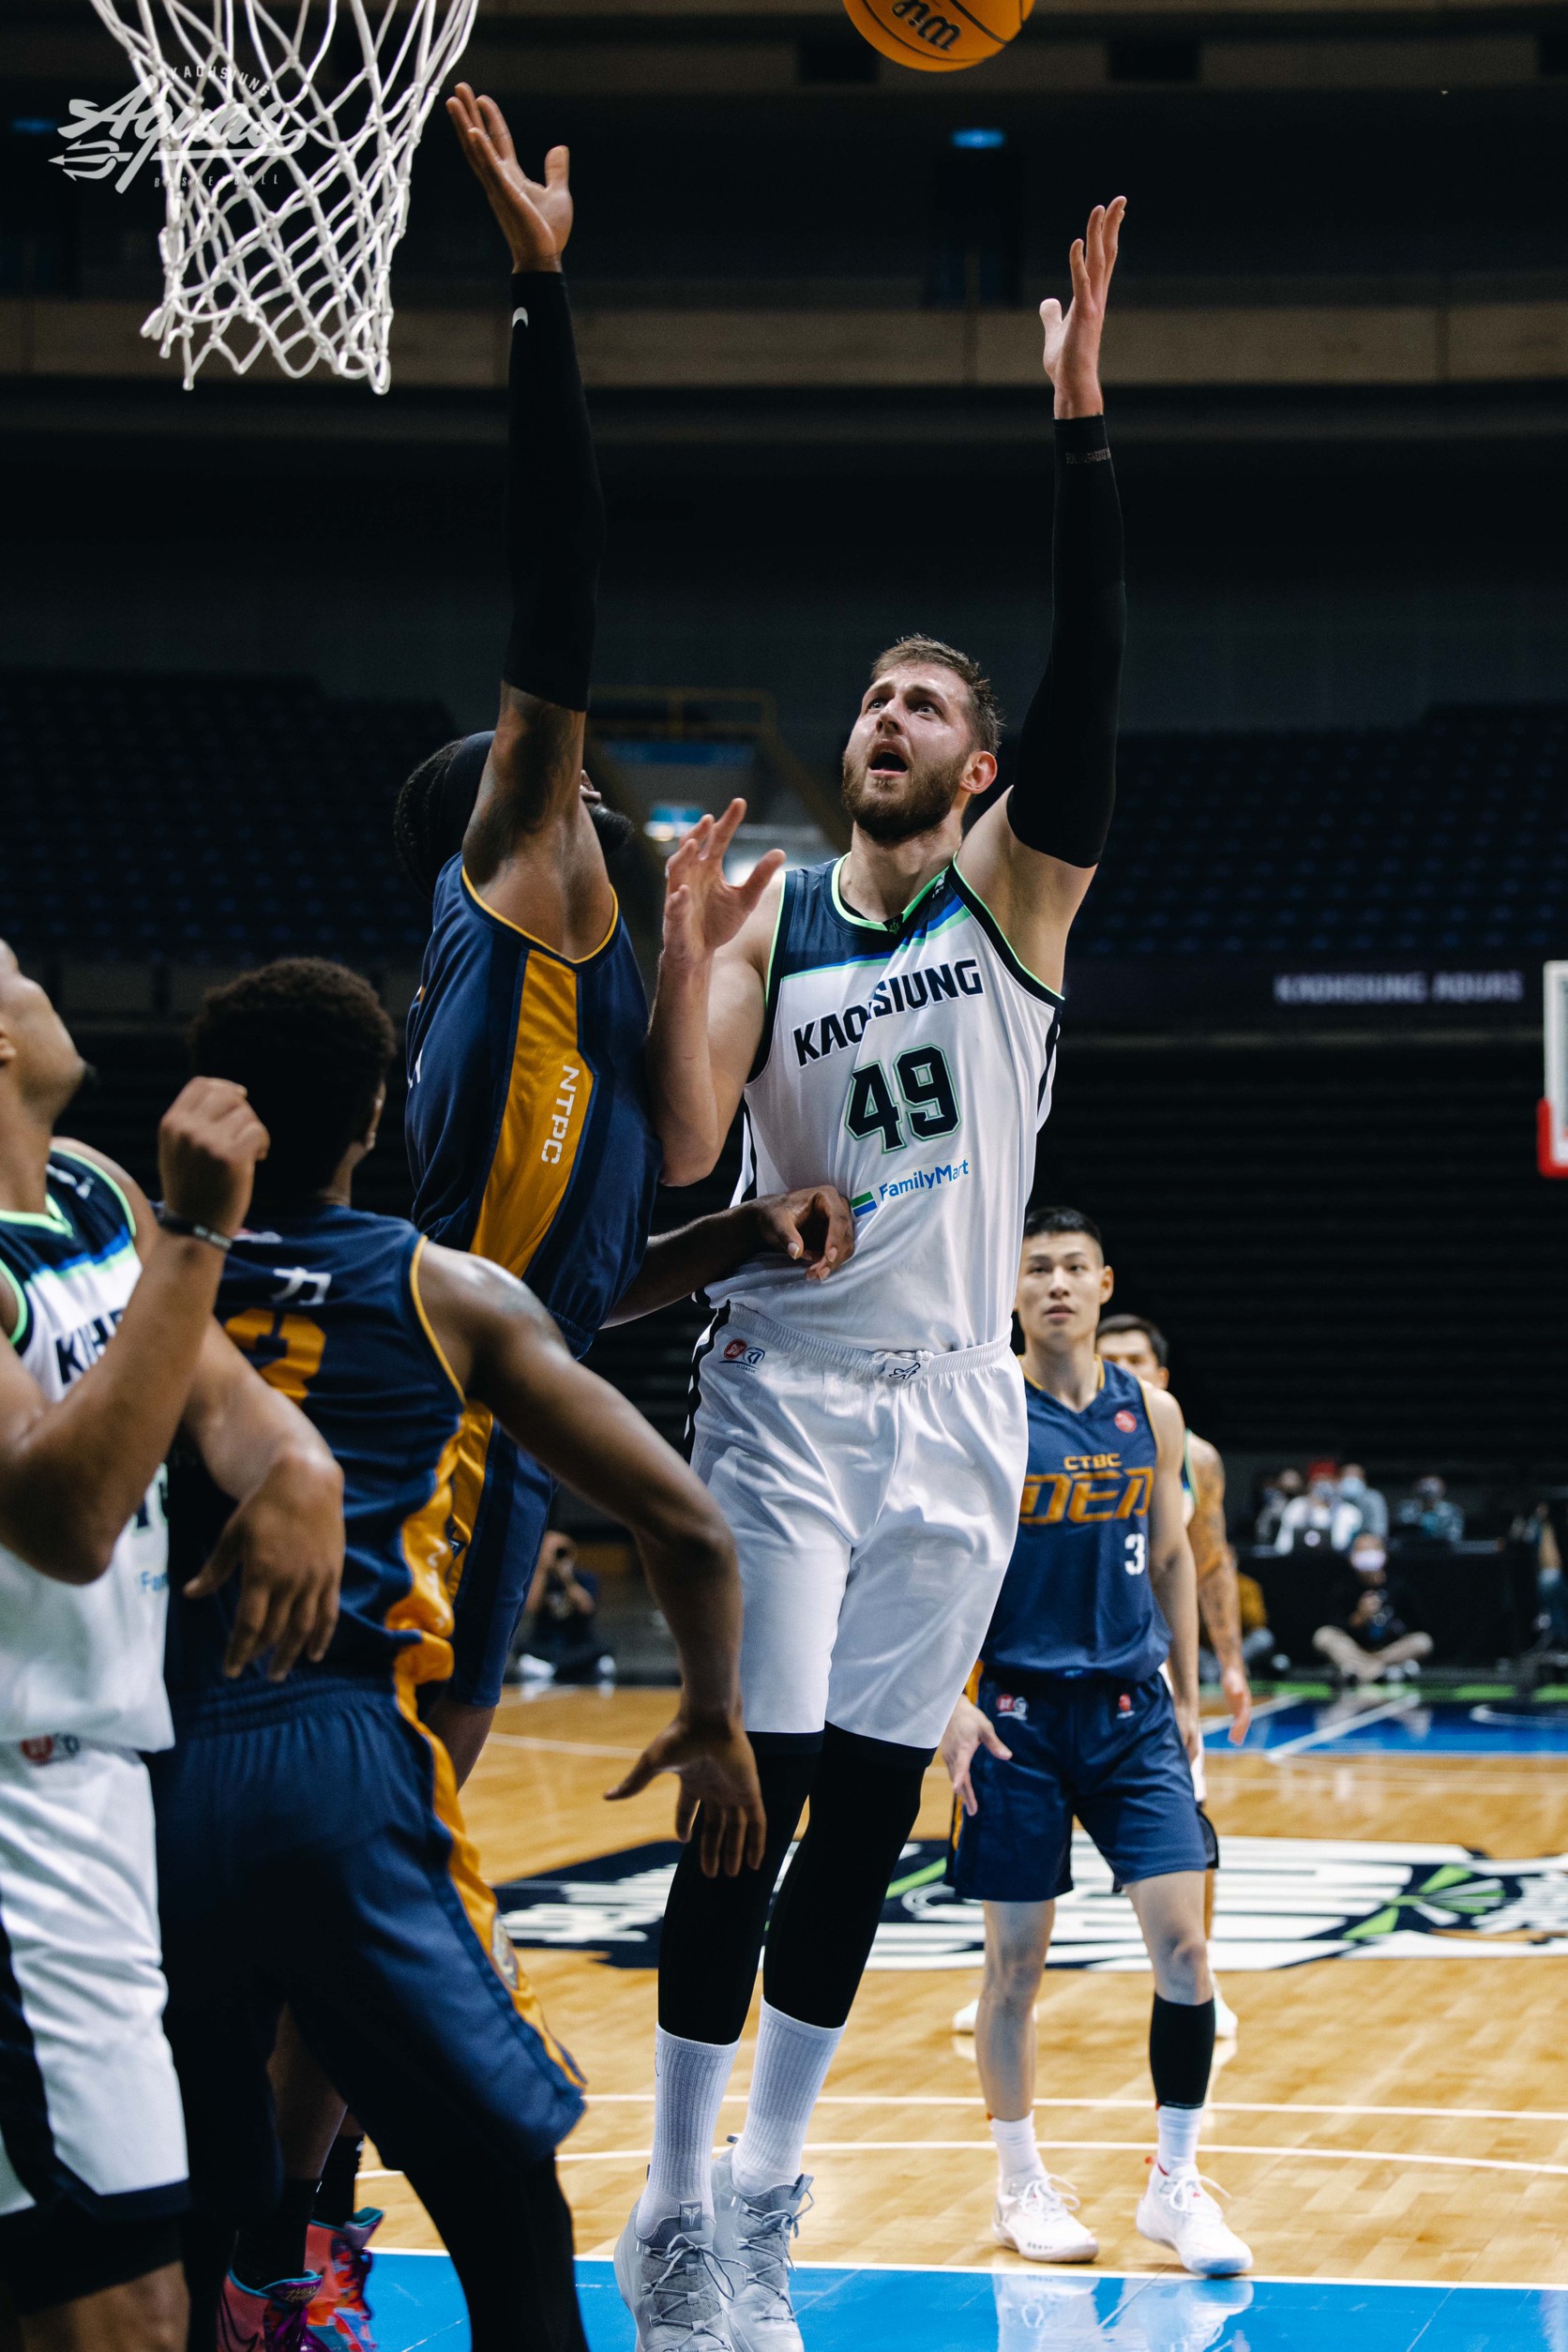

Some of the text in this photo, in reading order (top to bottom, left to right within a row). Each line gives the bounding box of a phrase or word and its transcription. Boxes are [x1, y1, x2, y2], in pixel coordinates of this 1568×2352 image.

[792, 957, 985, 1067] KAOSIUNG
[541, 1064, 580, 1165] NTPC
[844, 1044, 962, 1155] 49
[878, 1159, 970, 1201] FamilyMart
[1063, 1454, 1122, 1470] CTBC
[1124, 1532, 1146, 1576] 3
